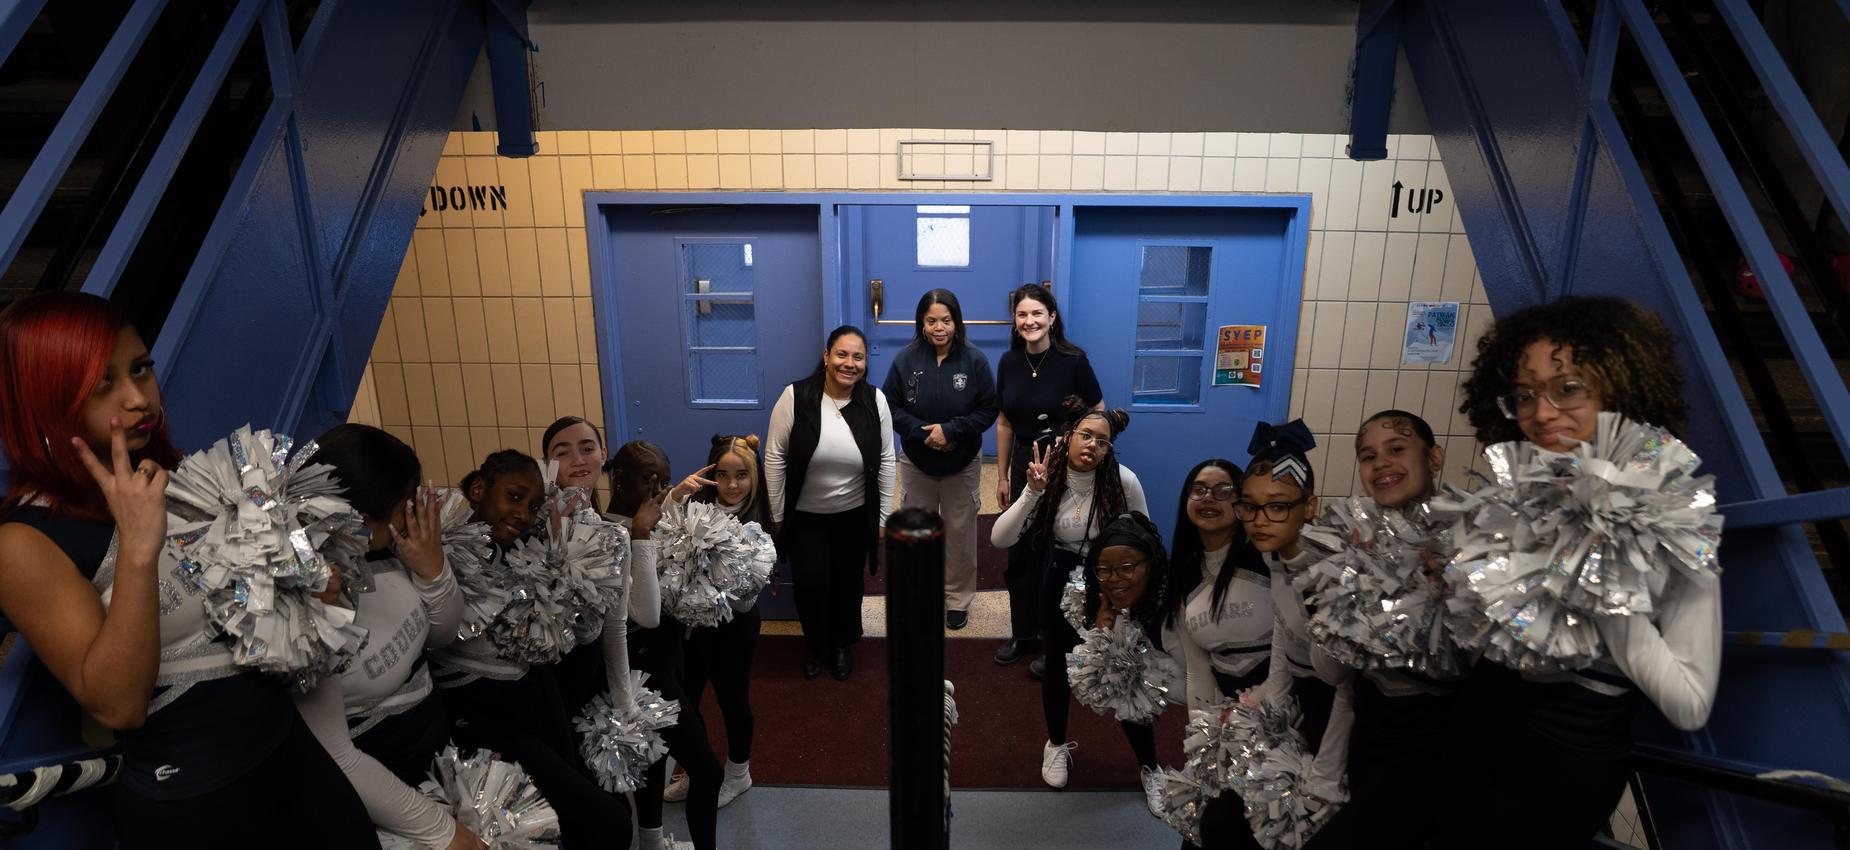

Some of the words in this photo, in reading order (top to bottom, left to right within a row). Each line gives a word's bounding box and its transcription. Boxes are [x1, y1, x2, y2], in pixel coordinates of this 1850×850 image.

[430, 186, 507, 211] DOWN
[1408, 188, 1444, 214] UP
[1223, 329, 1262, 341] SYEP
